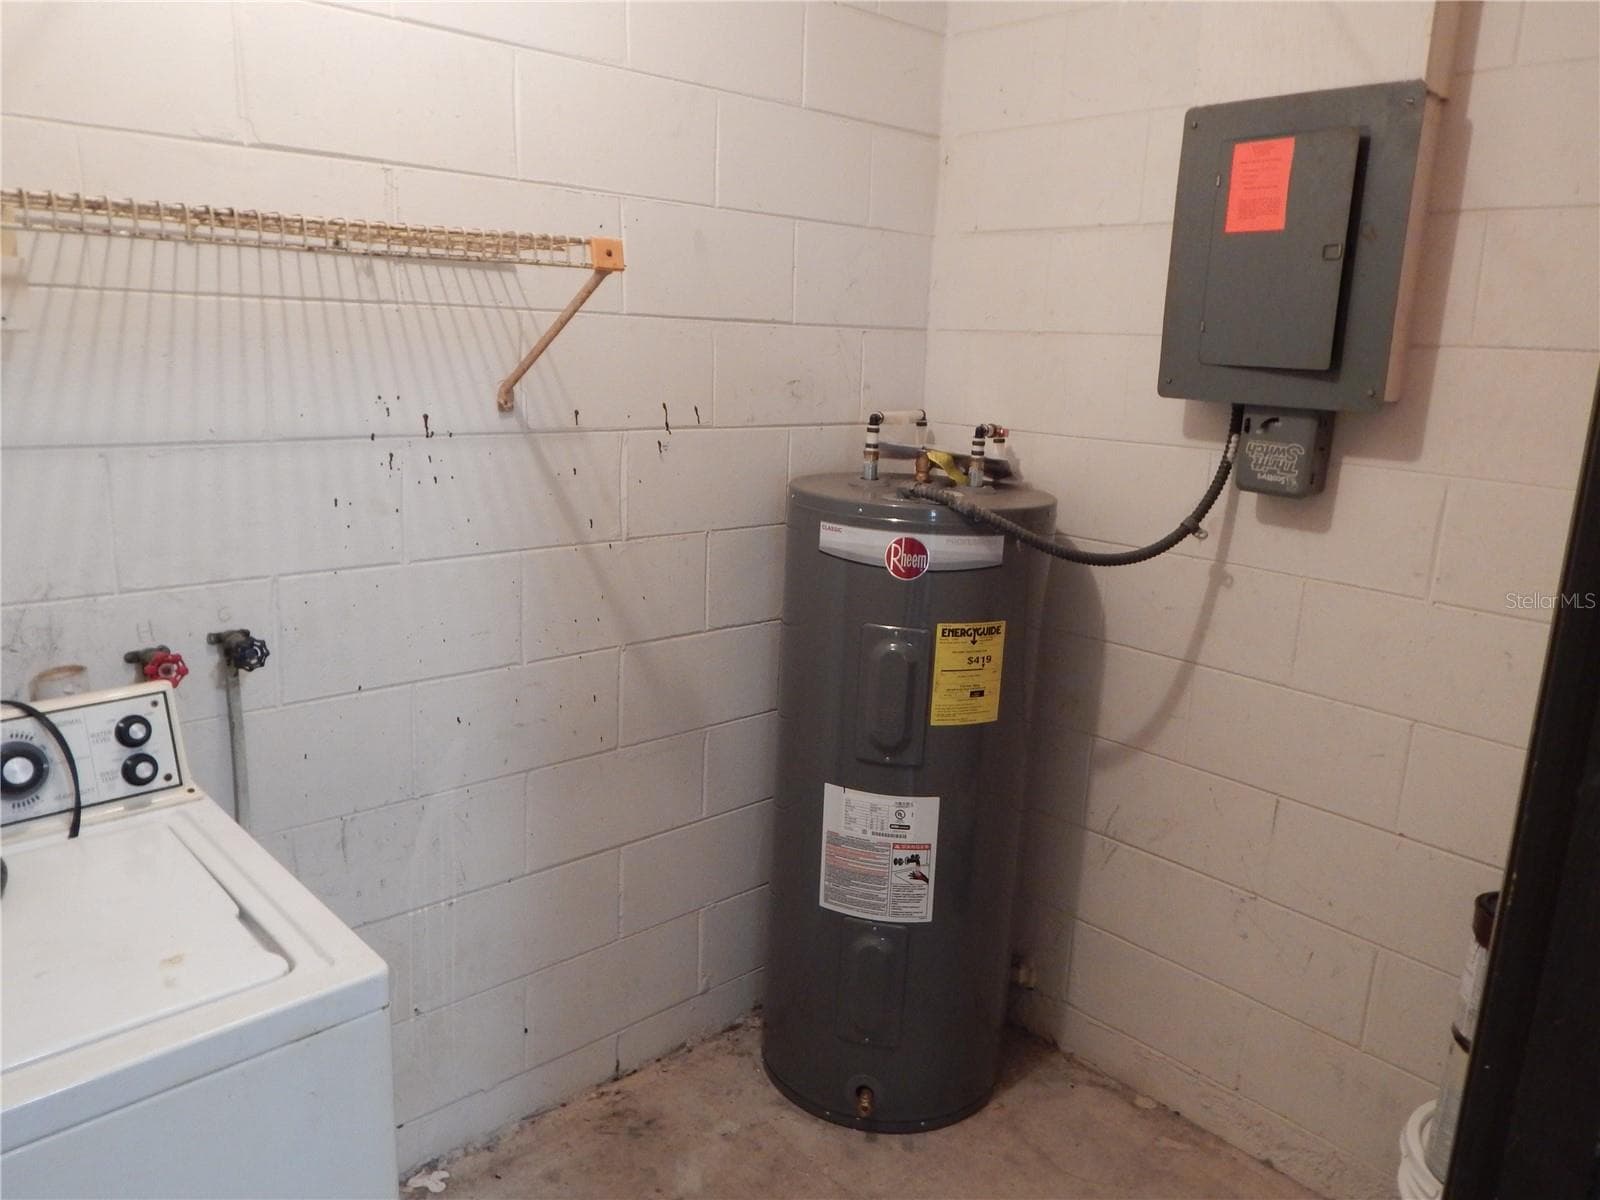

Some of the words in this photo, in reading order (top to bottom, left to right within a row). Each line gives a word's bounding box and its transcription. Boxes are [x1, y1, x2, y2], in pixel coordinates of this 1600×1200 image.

[1246, 440, 1304, 461] Switch
[1251, 453, 1299, 476] Thrift
[821, 524, 843, 534] CLASSIC
[889, 537, 927, 573] Rheem
